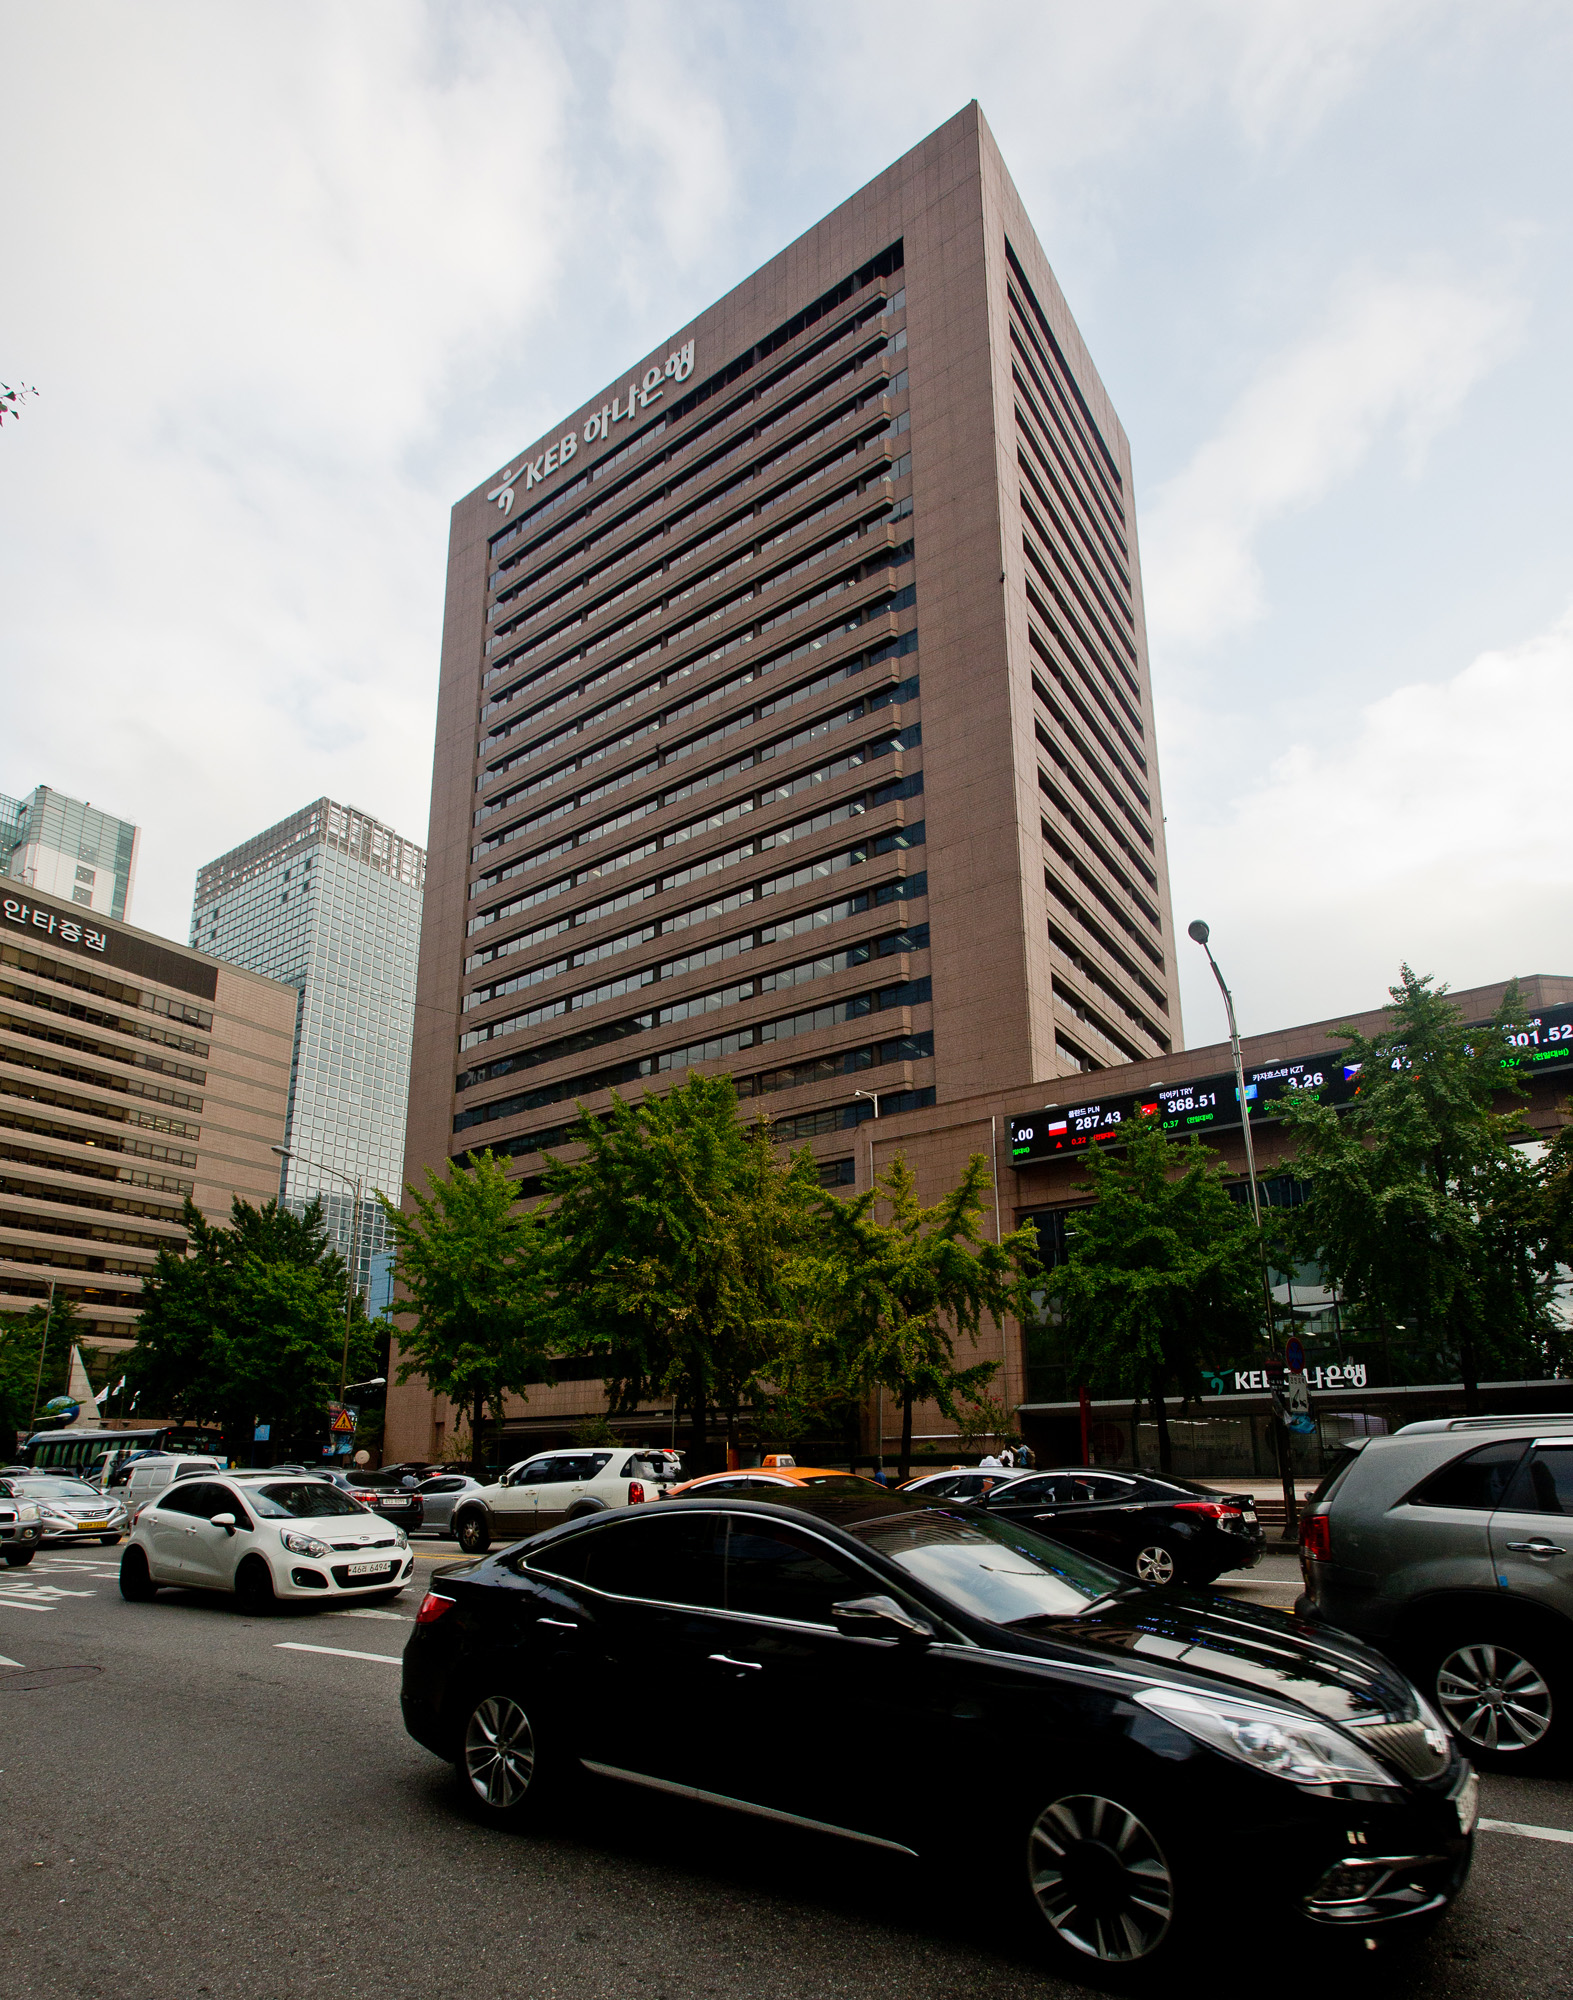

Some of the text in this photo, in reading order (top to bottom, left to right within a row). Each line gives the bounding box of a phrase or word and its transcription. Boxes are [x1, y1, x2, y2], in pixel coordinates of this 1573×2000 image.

[526, 338, 695, 490] KEB 하나은행
[3, 899, 107, 952] 안타증권
[1289, 1065, 1304, 1075] KZT
[1288, 1072, 1324, 1090] 3.26
[1179, 1086, 1194, 1096] TRY
[1087, 1105, 1100, 1115] PLN
[1167, 1093, 1216, 1113] 368.51
[1075, 1111, 1122, 1131] 287.43
[1163, 1120, 1179, 1129] 0.37
[1012, 1127, 1034, 1143] .00
[1071, 1136, 1087, 1146] 0.22
